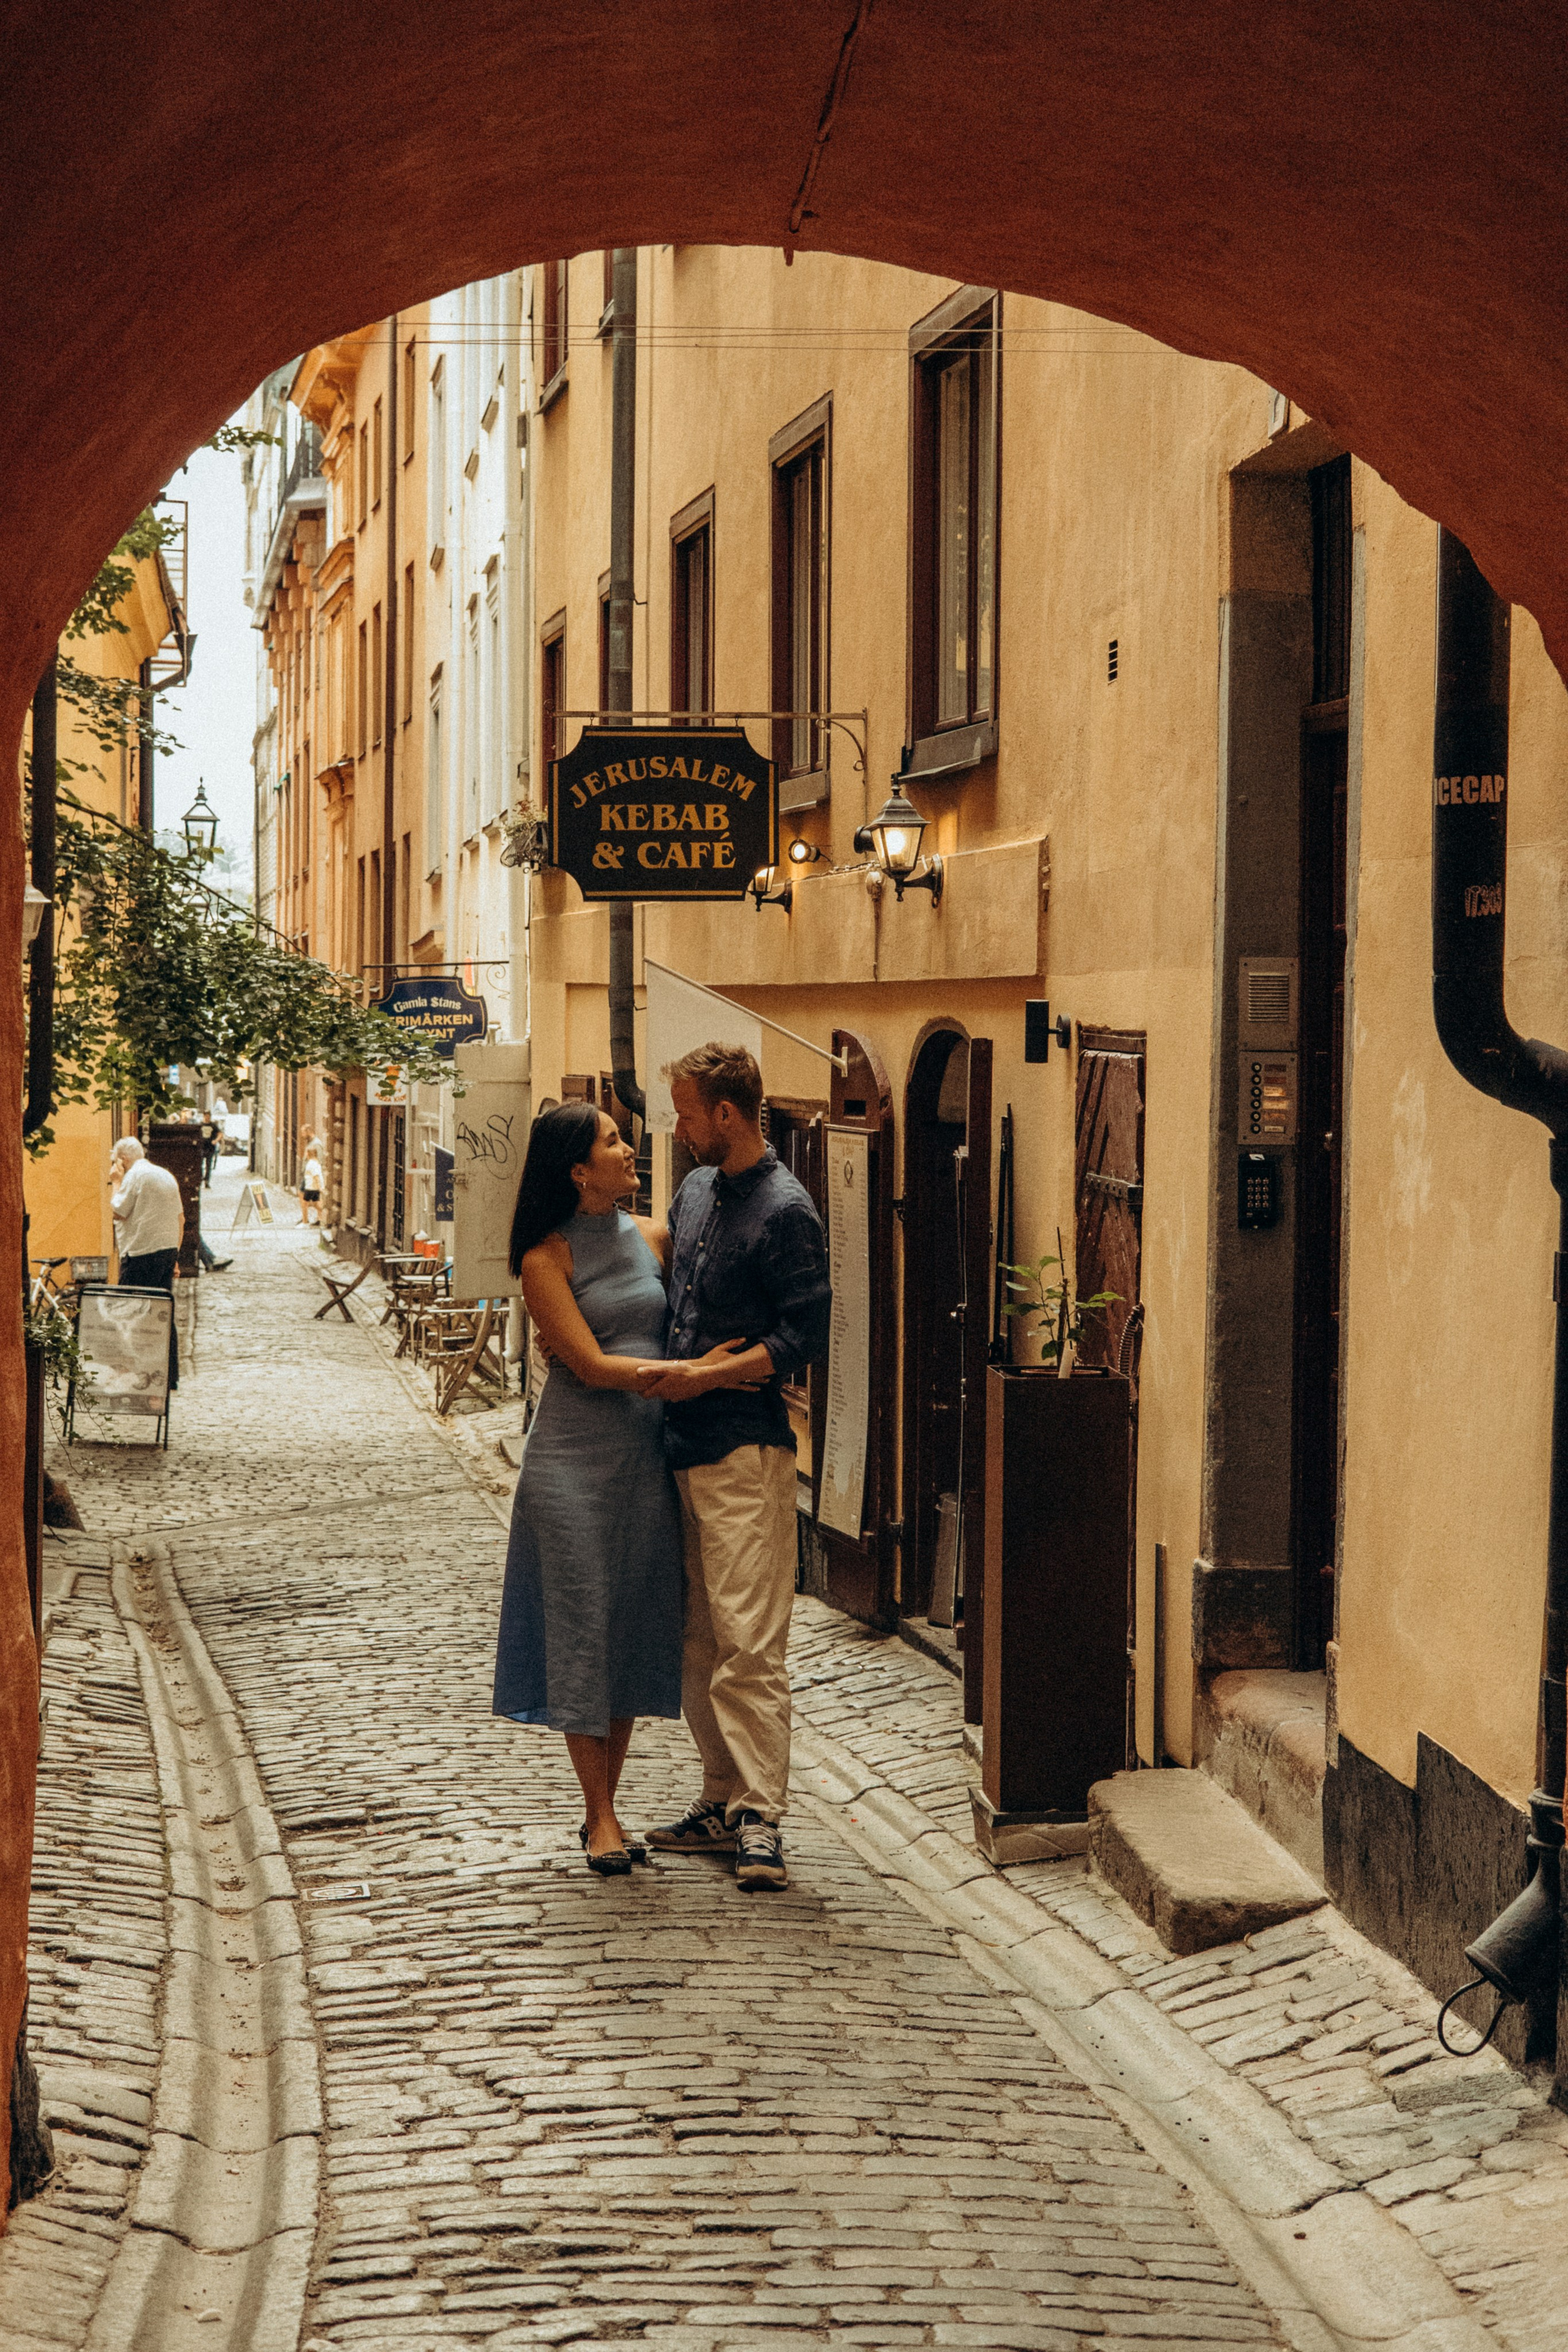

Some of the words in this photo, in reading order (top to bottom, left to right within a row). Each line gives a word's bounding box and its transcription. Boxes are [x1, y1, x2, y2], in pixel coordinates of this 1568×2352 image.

[569, 756, 757, 809] JERUSALEM
[600, 804, 729, 831] KEBAB
[592, 842, 625, 869] &
[637, 832, 736, 869] CAFÉ
[393, 996, 428, 1012] Gamla
[431, 997, 462, 1010] Stans
[423, 1028, 456, 1039] YNT
